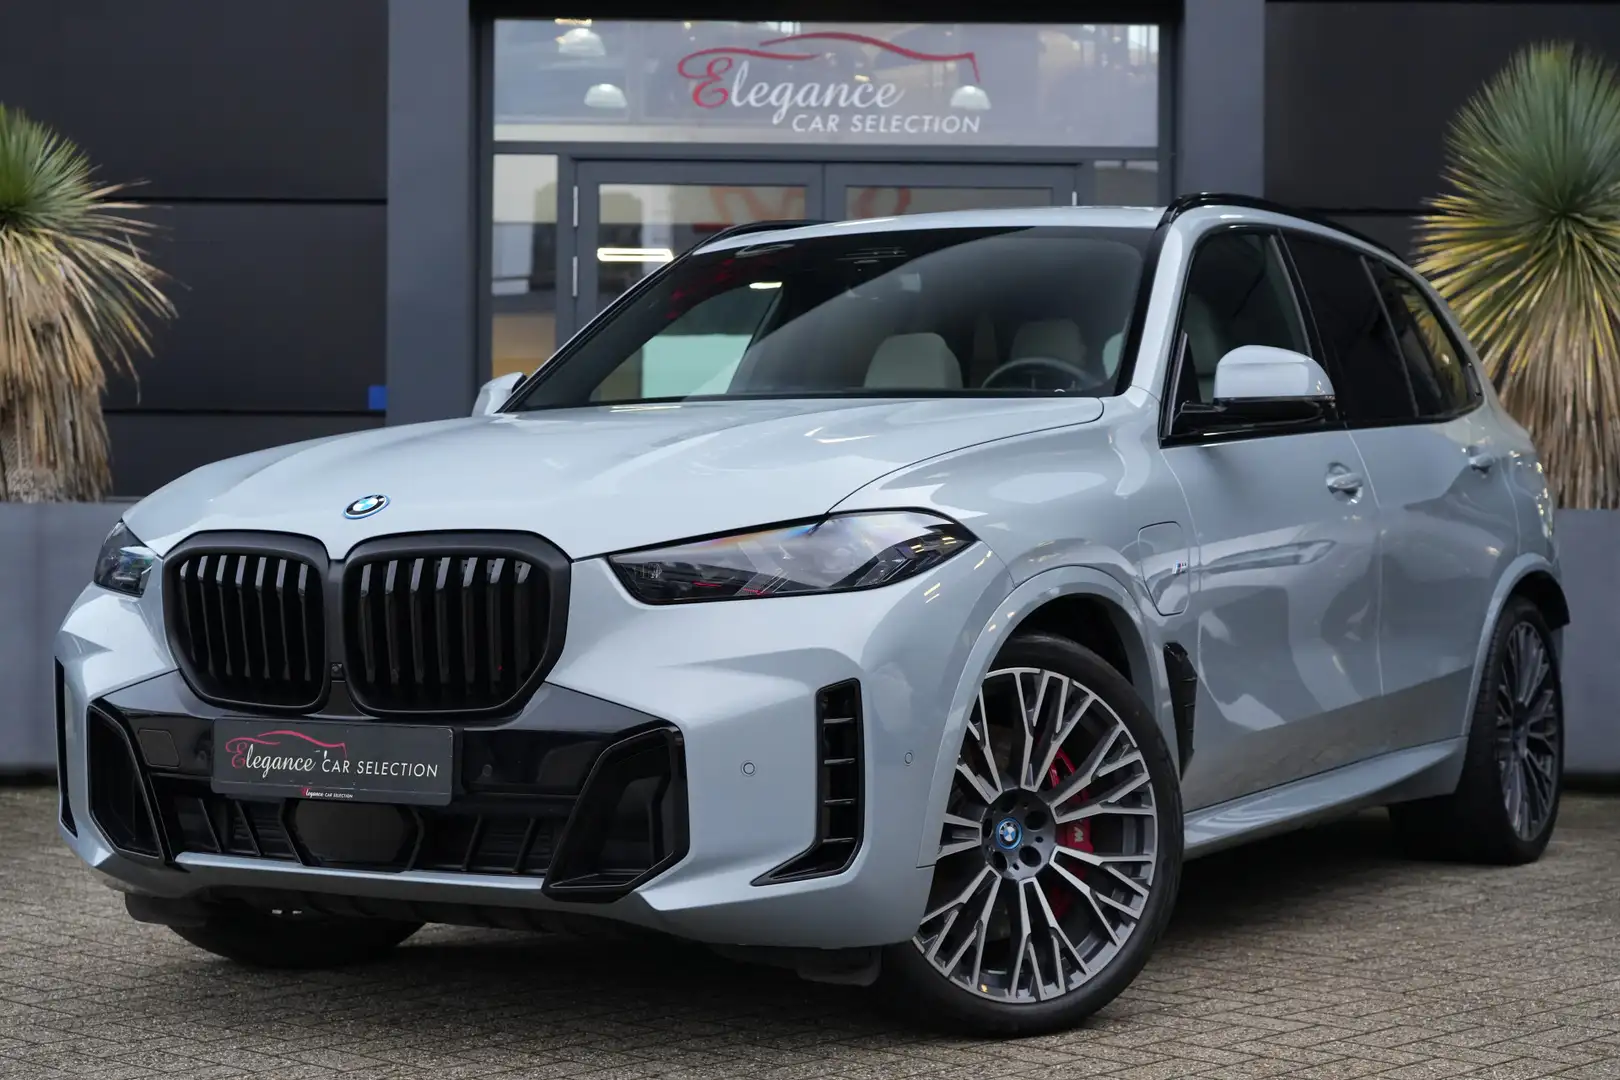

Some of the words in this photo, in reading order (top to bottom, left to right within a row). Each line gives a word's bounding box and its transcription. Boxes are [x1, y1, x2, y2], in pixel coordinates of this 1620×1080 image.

[677, 51, 902, 125] Elegance
[792, 114, 839, 132] CAR
[850, 114, 981, 133] SELECTION
[225, 738, 317, 779] Elegance
[321, 759, 350, 774] CAR
[356, 760, 438, 778] SELECTION
